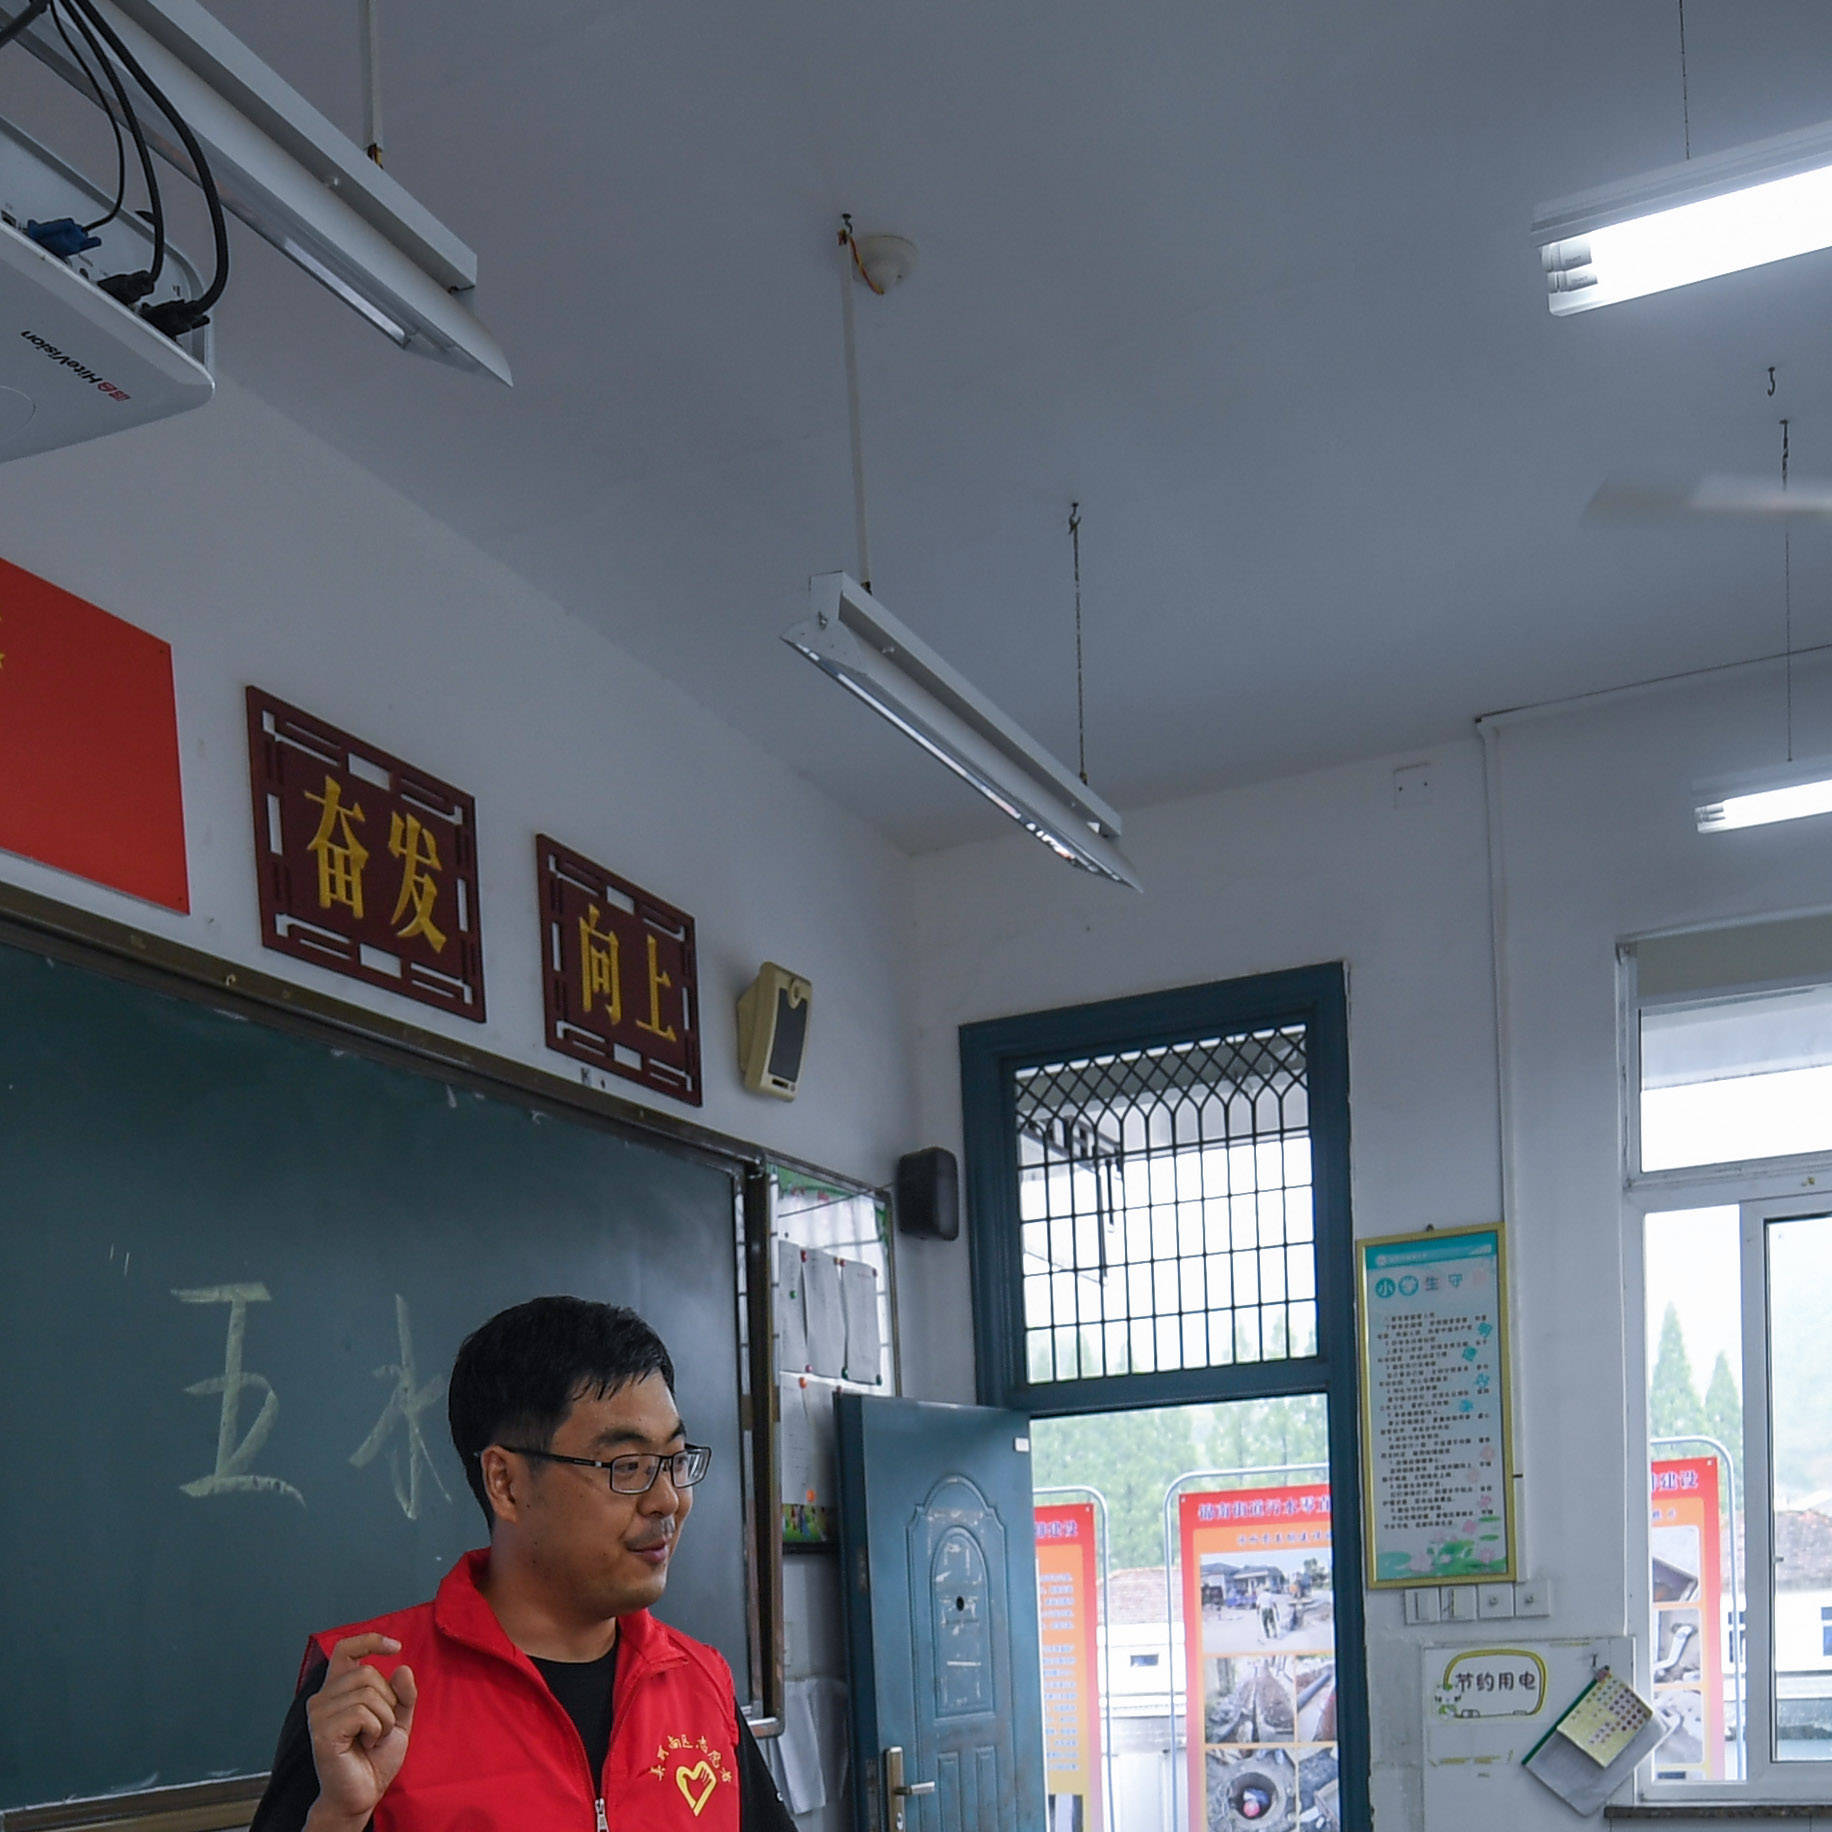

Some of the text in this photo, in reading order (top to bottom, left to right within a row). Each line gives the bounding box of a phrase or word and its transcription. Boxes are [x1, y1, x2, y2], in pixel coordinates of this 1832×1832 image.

[304, 775, 447, 954] 奋发
[577, 904, 677, 1043] 向上
[1455, 1671, 1536, 1692] 节约用电
